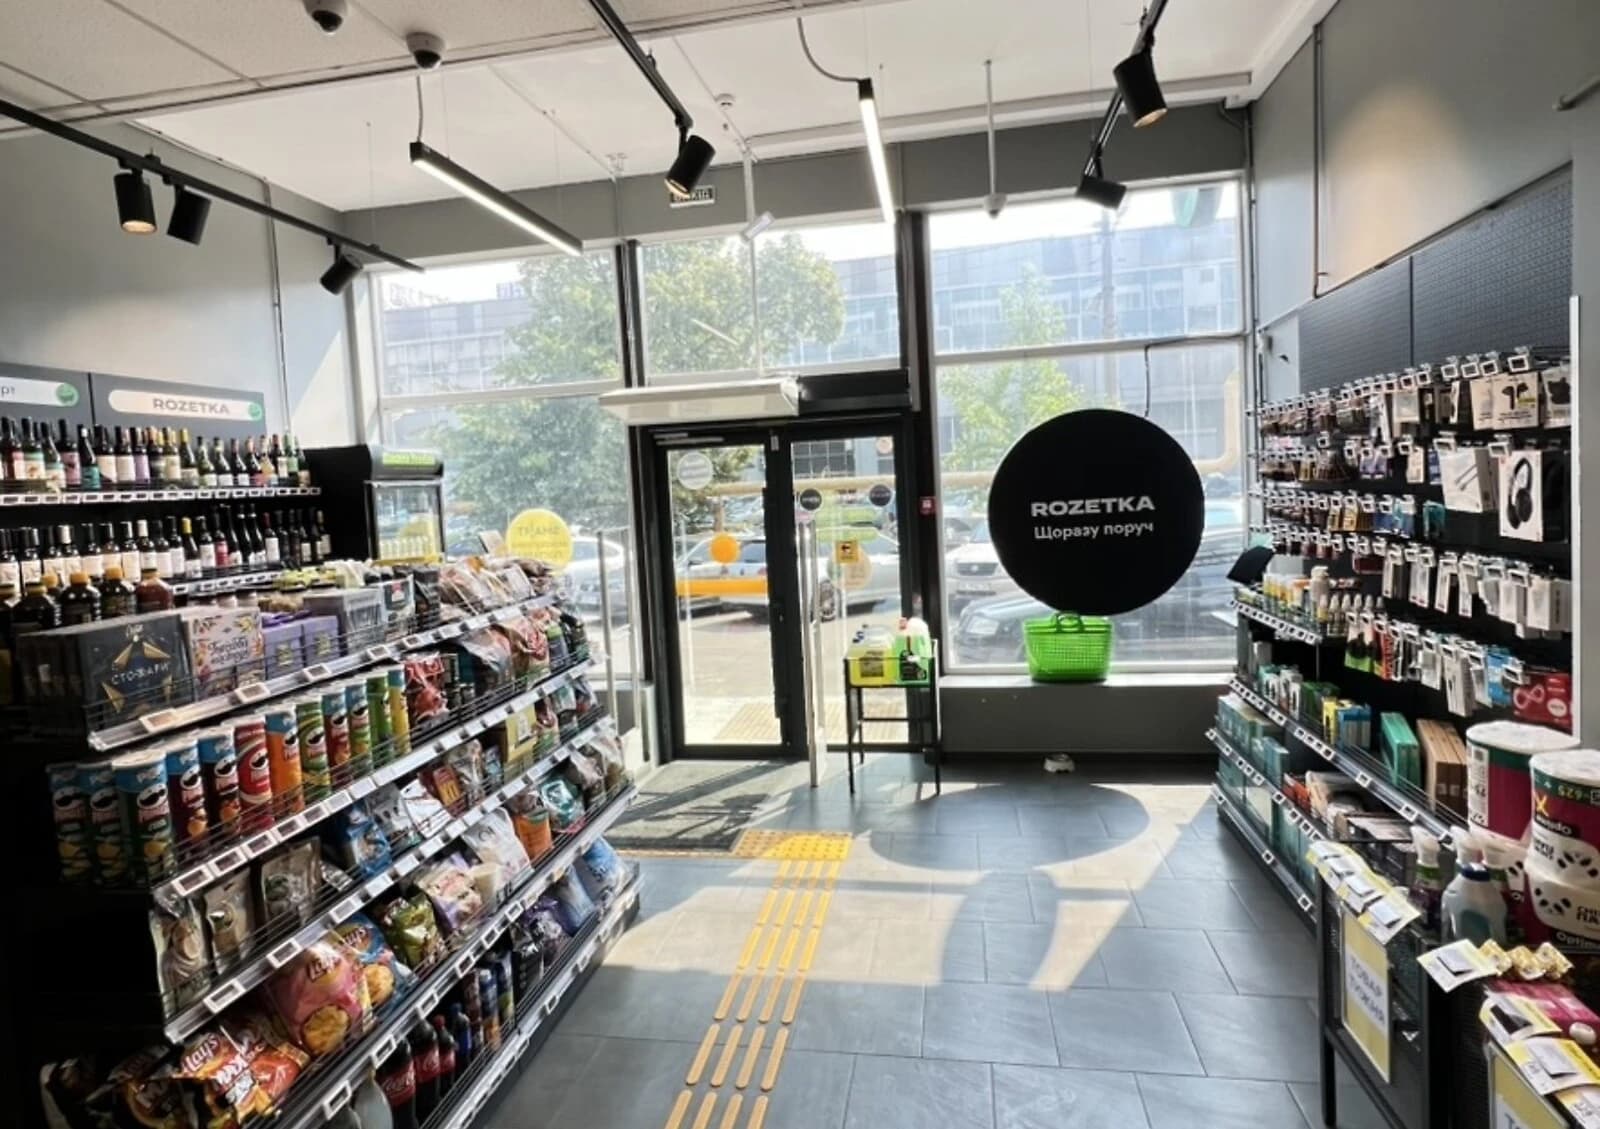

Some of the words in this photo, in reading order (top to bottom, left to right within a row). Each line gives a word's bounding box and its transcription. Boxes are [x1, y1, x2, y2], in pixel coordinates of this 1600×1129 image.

[152, 397, 231, 417] ROZETKA
[1030, 495, 1156, 517] ROZETKA
[1034, 523, 1100, 541] Щоразу
[1103, 520, 1155, 539] поруч
